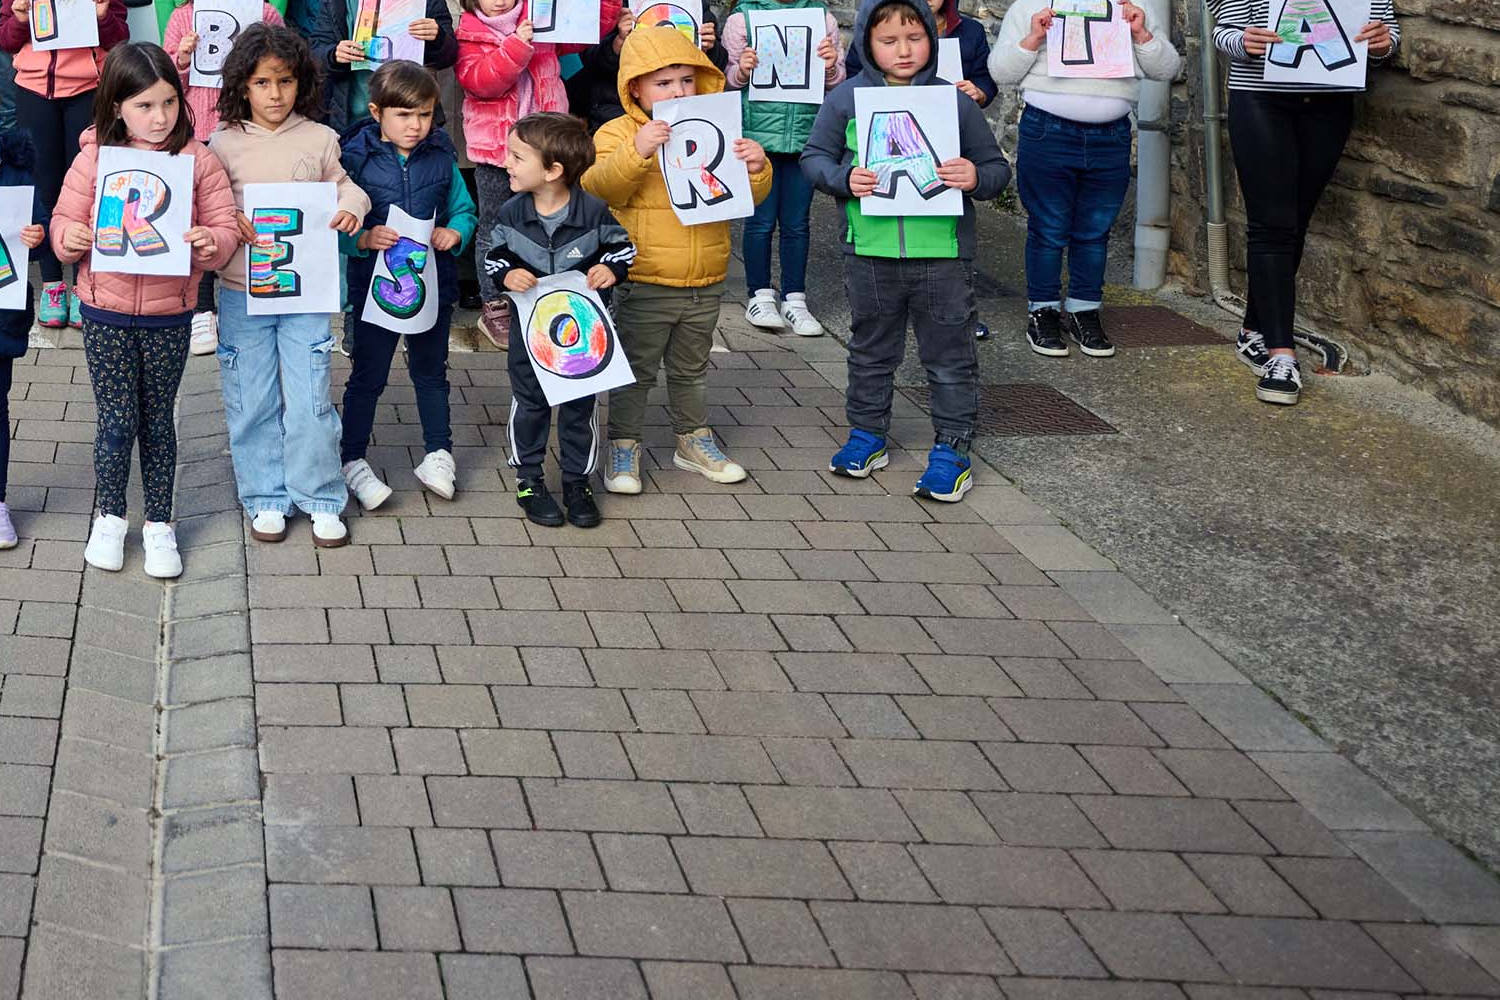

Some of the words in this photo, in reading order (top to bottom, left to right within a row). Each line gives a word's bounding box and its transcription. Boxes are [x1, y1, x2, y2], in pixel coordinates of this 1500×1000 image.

[194, 10, 241, 75] B
[752, 24, 811, 90] N
[662, 118, 733, 210] R
[863, 110, 949, 200] A
[95, 170, 172, 257] R
[250, 207, 304, 298] E
[372, 236, 429, 318] S
[525, 288, 615, 379] O
